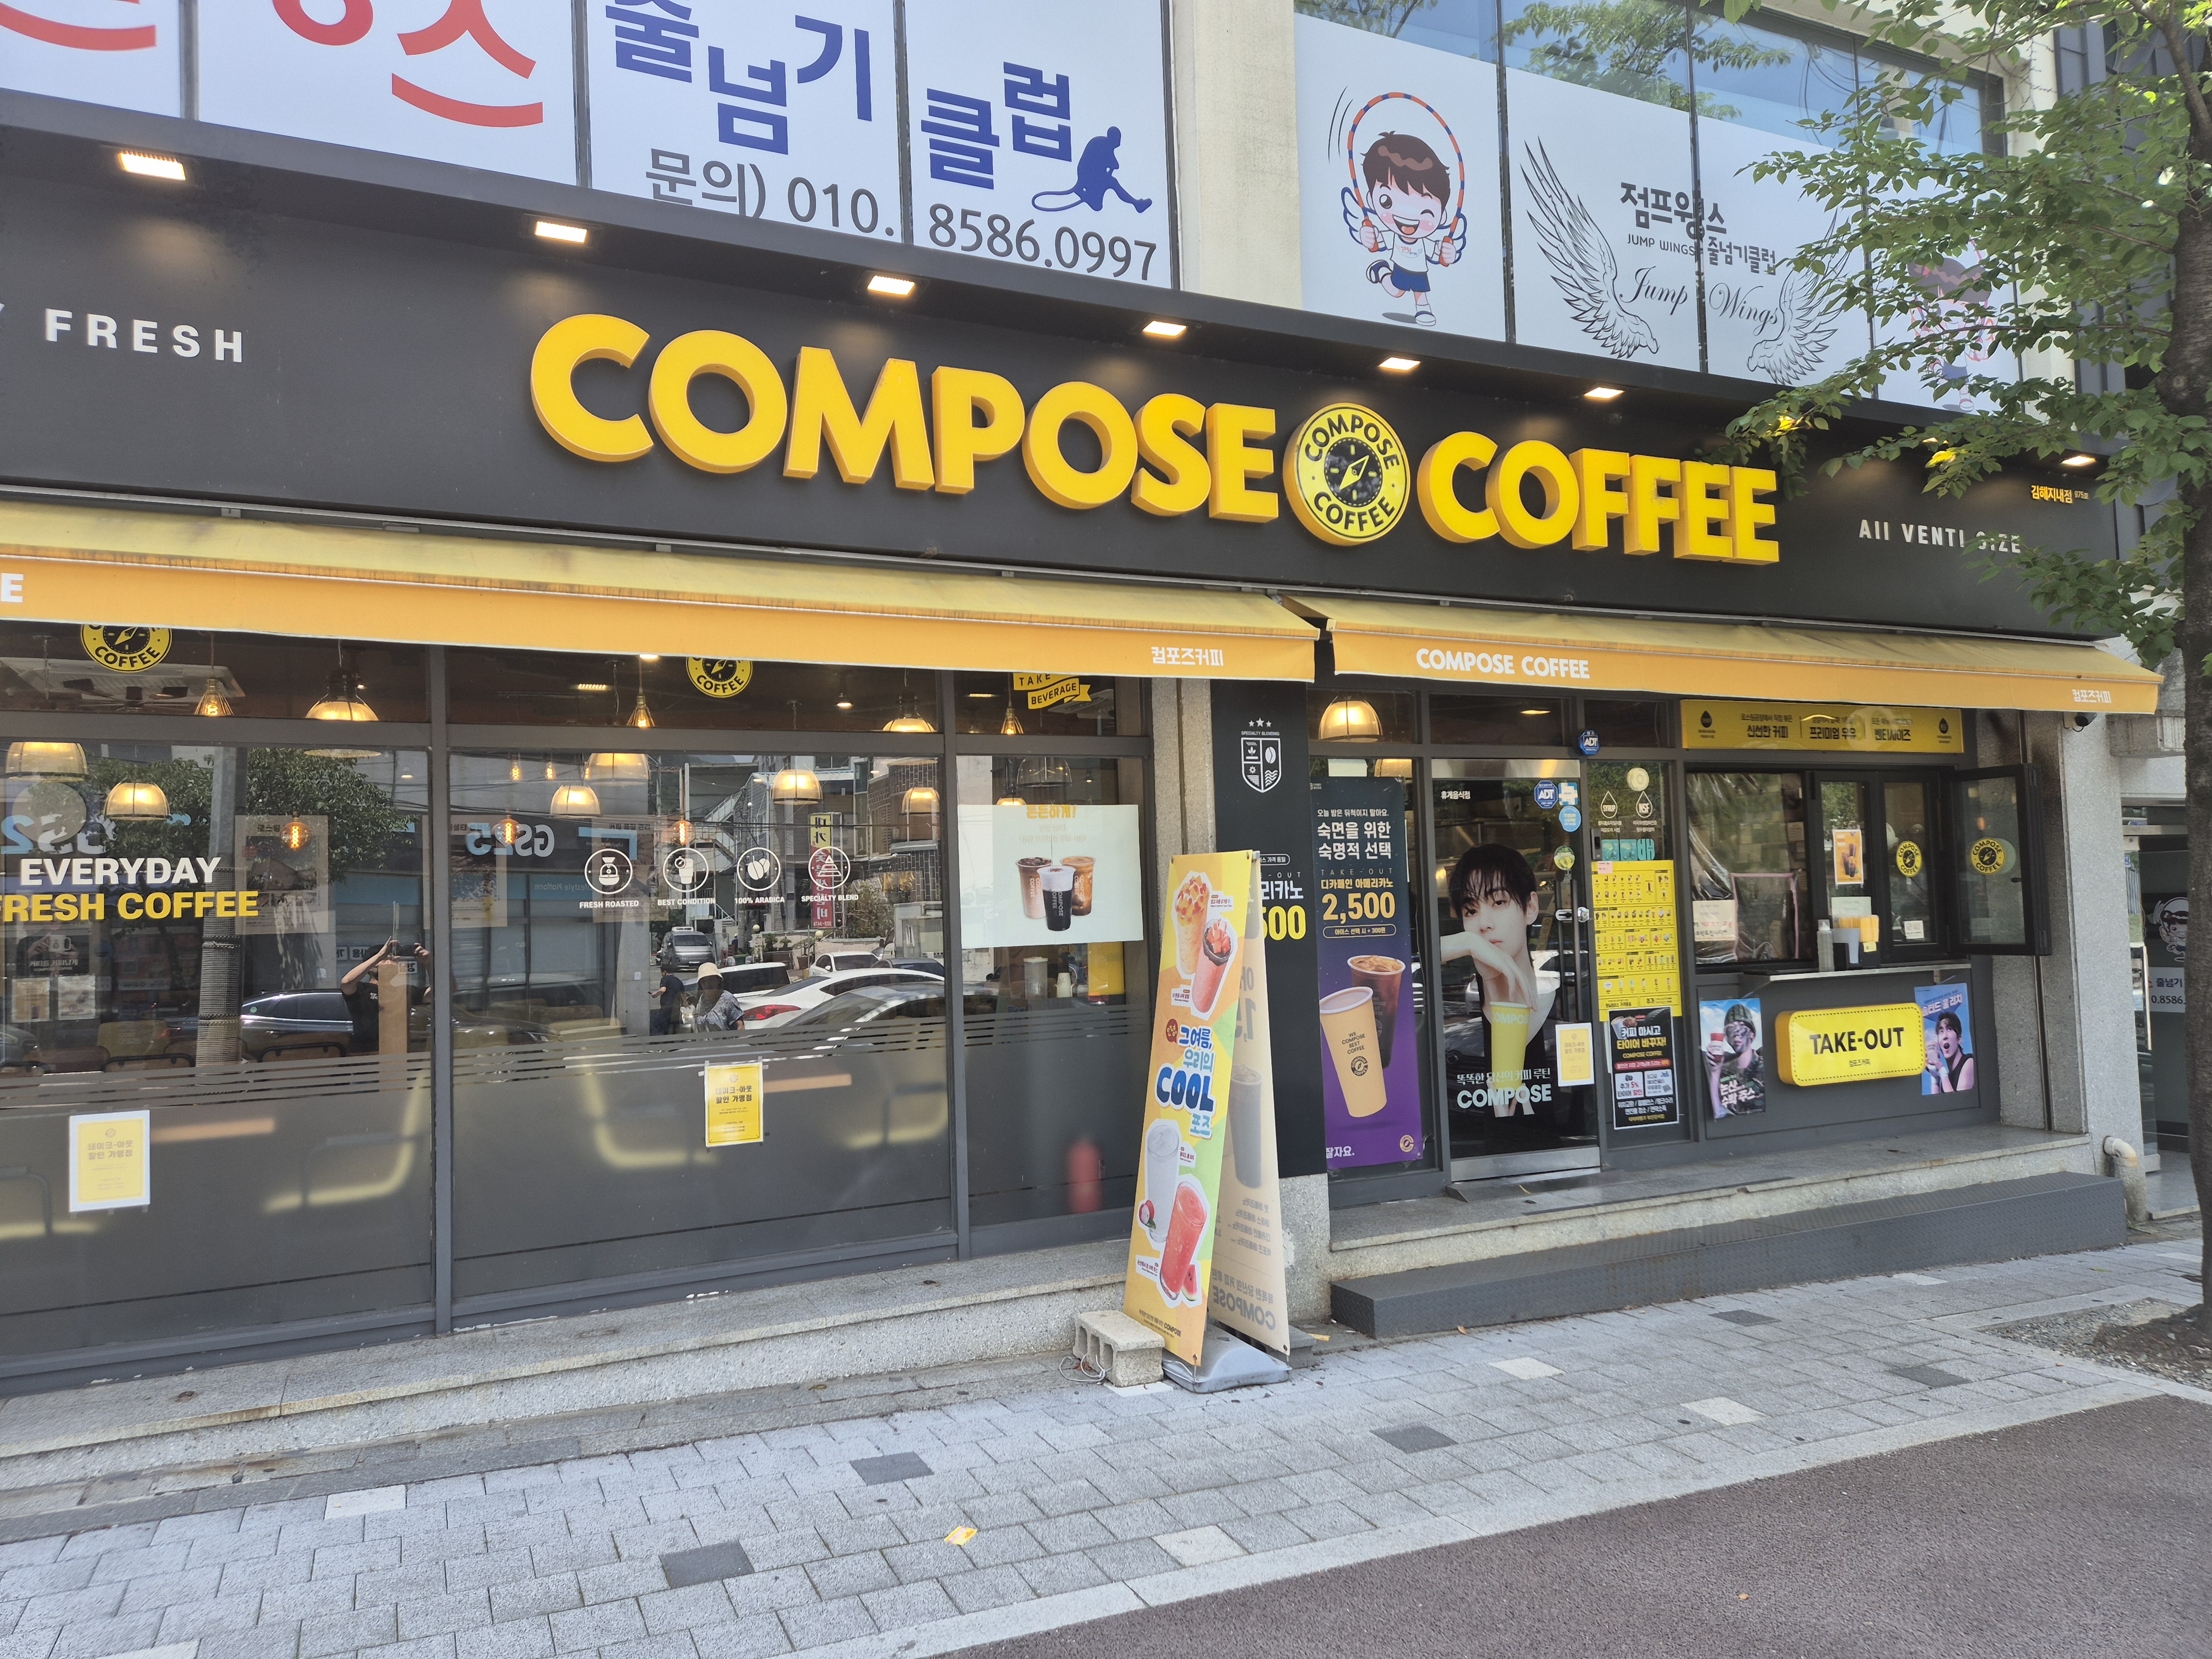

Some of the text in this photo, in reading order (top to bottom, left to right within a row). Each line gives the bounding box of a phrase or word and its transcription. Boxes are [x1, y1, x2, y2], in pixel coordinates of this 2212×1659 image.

[921, 61, 1072, 190] 클럽
[1620, 181, 1727, 240] 점프윙스
[787, 175, 895, 237] 010.
[928, 202, 1157, 281] 8586.0997
[1627, 233, 1695, 256] JUMP WINGS
[1707, 236, 1776, 276] 줄넘기클럽
[1619, 265, 1778, 336] Jump Wings
[45, 308, 243, 363] FRESH
[530, 314, 1781, 565] COMPOSE COFFEE
[1305, 414, 1400, 469] COMPOSE
[2031, 484, 2073, 504] 김해지내점
[1314, 491, 1395, 531] COFFEE
[1901, 523, 1964, 547] VENTI
[94, 646, 160, 668] COFFEE
[1150, 646, 1224, 666] 컴포즈커피
[1417, 648, 1590, 679] COMPOSE COFFEE
[696, 674, 744, 694] COFFEE
[1019, 672, 1051, 687] TAKE
[1030, 682, 1077, 706] BEVERAGE
[2072, 689, 2112, 703] 컴포즈커피
[1747, 725, 1788, 738] 신선한 커피
[1809, 727, 1856, 739] 프리미엄 우유
[1583, 737, 1598, 747] ADT
[1441, 790, 1471, 800] 휴게음식점
[1538, 789, 1554, 800] ADT
[1026, 804, 1077, 819] 든든하게!
[1317, 808, 1389, 817] 오늘 밤은 뒤척이지 말아요.
[1317, 821, 1391, 839] 숙면을 위한
[1318, 841, 1392, 860] 숙명적 선택
[1898, 843, 1919, 857] COMPOSE
[1973, 840, 2002, 855] COMPOSE
[20, 857, 221, 885] EVERYDAY
[1321, 868, 1393, 877] TAKE-OUT
[1901, 864, 1919, 874] COFFEE
[1976, 861, 2001, 872] COFFEE
[1321, 878, 1394, 890] 디카페인 아메리카노
[0, 891, 259, 922] RESH COFFEE
[1322, 891, 1396, 925] 2,500
[2156, 978, 2183, 988] 줄넘기
[1942, 998, 1949, 1010] 쿨
[1949, 992, 1963, 1006] 리치
[1342, 1033, 1365, 1045] COMPOSE
[1621, 1025, 1662, 1039] 커피 마시고
[1809, 1027, 1905, 1055] TAKE-OUT
[1347, 1045, 1365, 1055] COFFEE
[1616, 1037, 1667, 1050] 타이어 바꾸자!
[1183, 1049, 1214, 1073] 우리의
[1457, 1067, 1551, 1085] 똑똑한 당신의 커피 루틴
[716, 1085, 753, 1095] 테이크-아웃
[732, 1094, 752, 1103] 가맹점
[1156, 1067, 1214, 1112] COOL
[1457, 1084, 1552, 1109] COMPOSE
[1738, 1087, 1756, 1102] 주스
[1190, 1113, 1211, 1136] 포즈
[88, 1140, 133, 1151] 테이크-아웃
[108, 1149, 133, 1158] 가맹점
[1326, 1145, 1355, 1159] 잘자요.
[1164, 1322, 1182, 1337] COMPOSE
